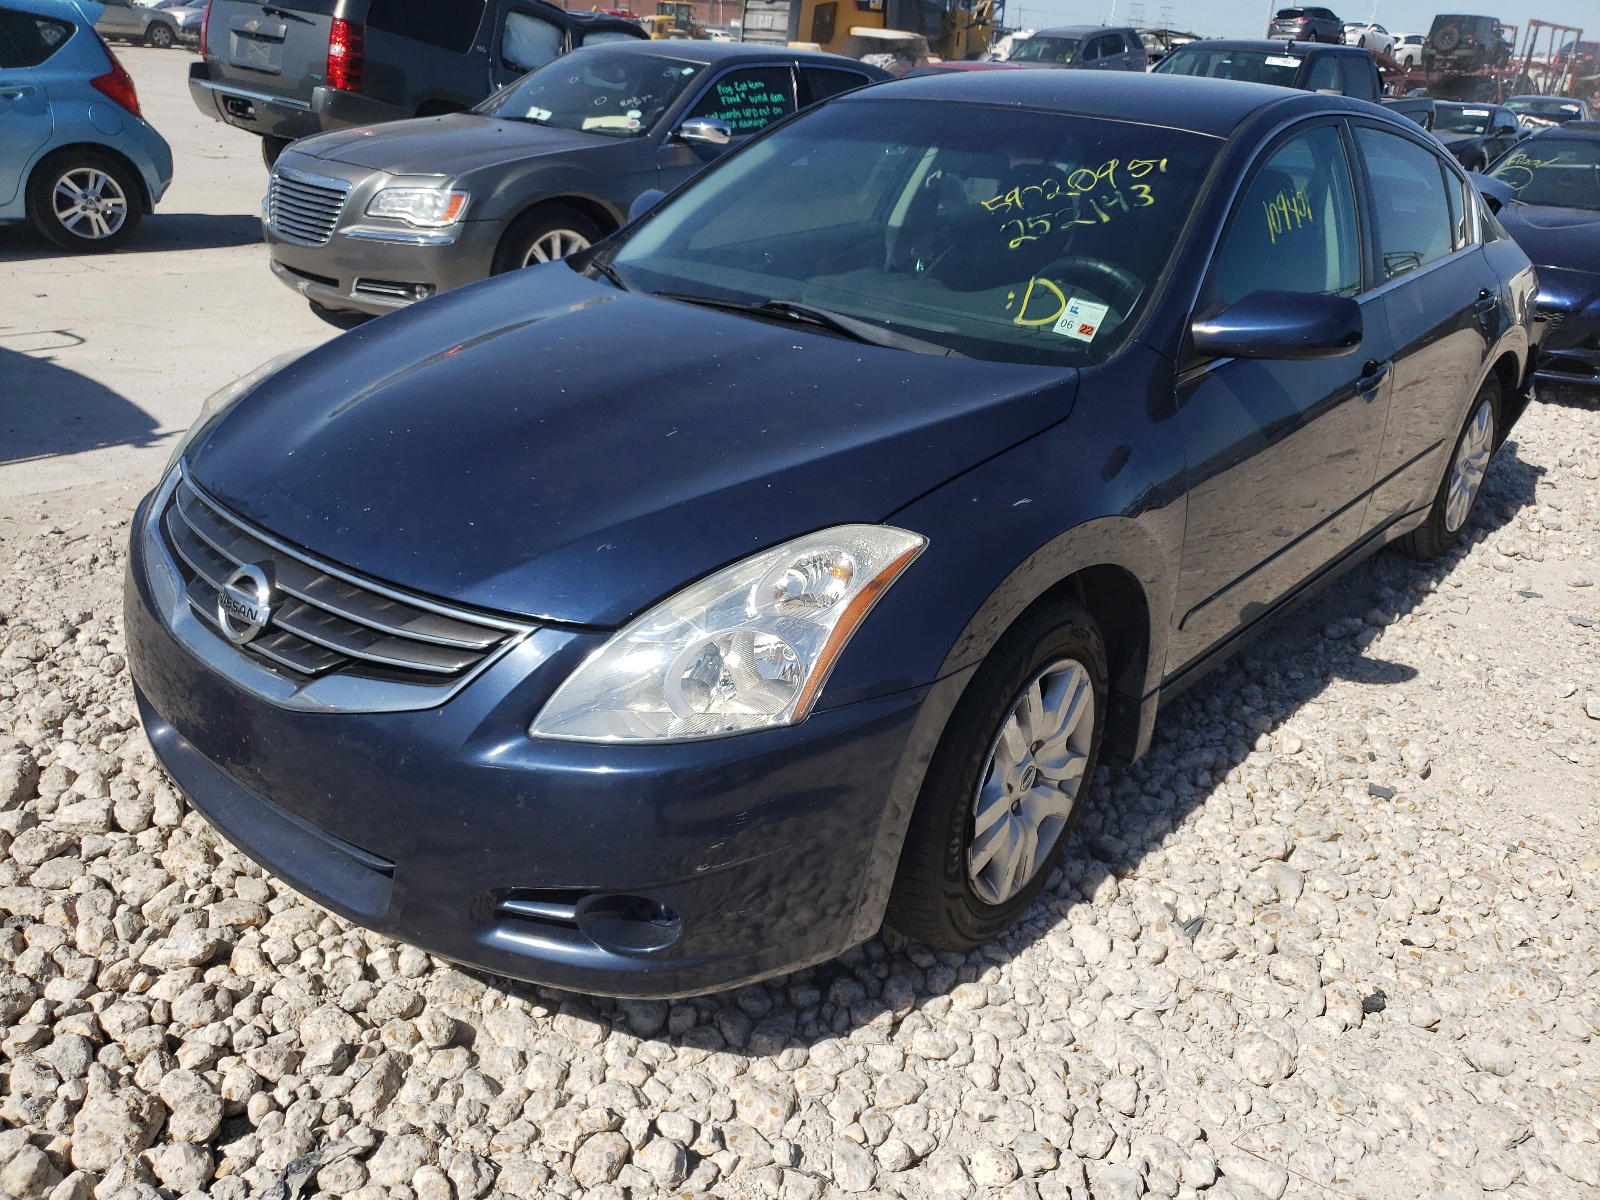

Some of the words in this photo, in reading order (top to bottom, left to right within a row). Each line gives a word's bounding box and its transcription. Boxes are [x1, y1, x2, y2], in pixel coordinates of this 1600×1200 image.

[1060, 318, 1074, 329] 06
[1079, 323, 1094, 337] 22
[219, 591, 259, 621] NISSAN
